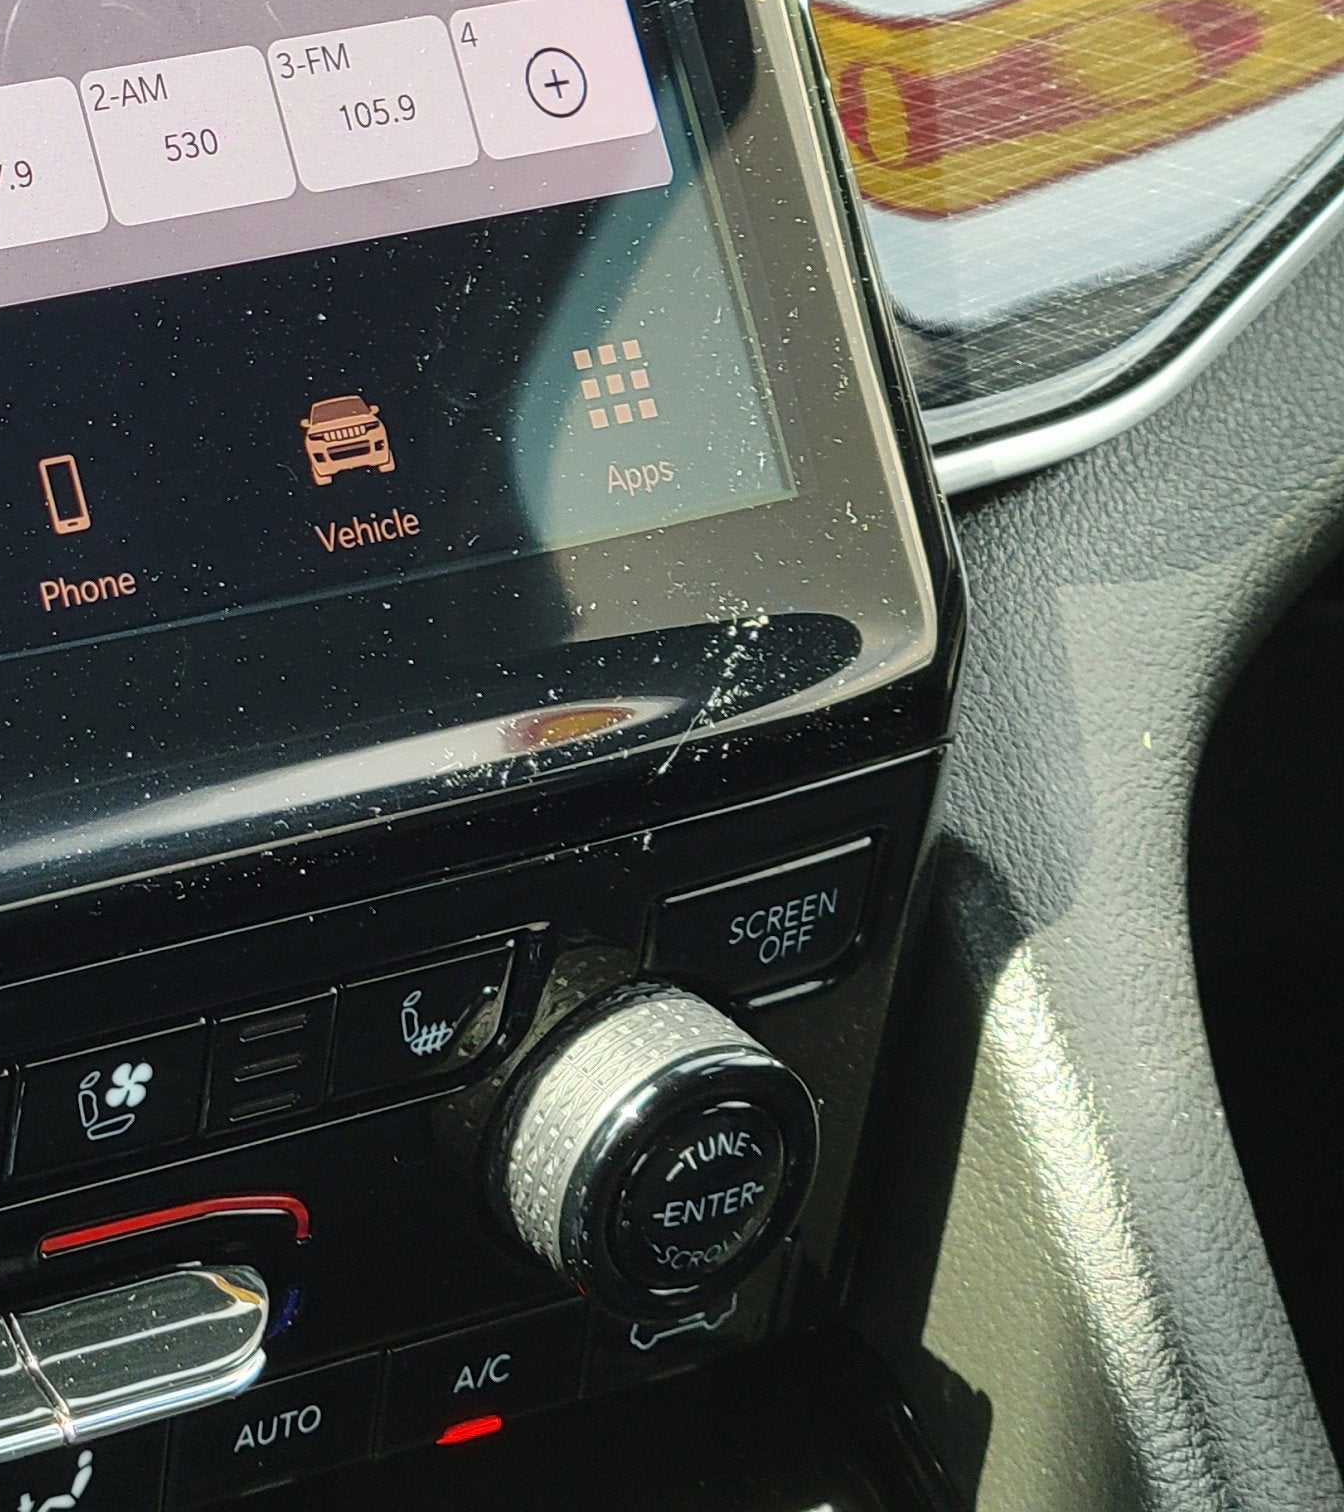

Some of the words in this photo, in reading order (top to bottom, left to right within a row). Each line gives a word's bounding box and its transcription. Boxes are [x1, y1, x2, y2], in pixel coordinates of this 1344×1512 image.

[459, 20, 480, 48] 4
[275, 41, 352, 80] 3-FM
[88, 72, 170, 113] 2-AM
[338, 94, 418, 132] 105.9
[163, 128, 219, 162] 530
[605, 455, 676, 495] Apps
[314, 508, 421, 553] Vehicle
[39, 567, 137, 614] Phone
[727, 887, 839, 946] SCREEN
[758, 925, 813, 965] OFF
[678, 1131, 751, 1171] TUNE
[452, 1353, 512, 1394] A/C
[233, 1404, 322, 1453] AUTO
